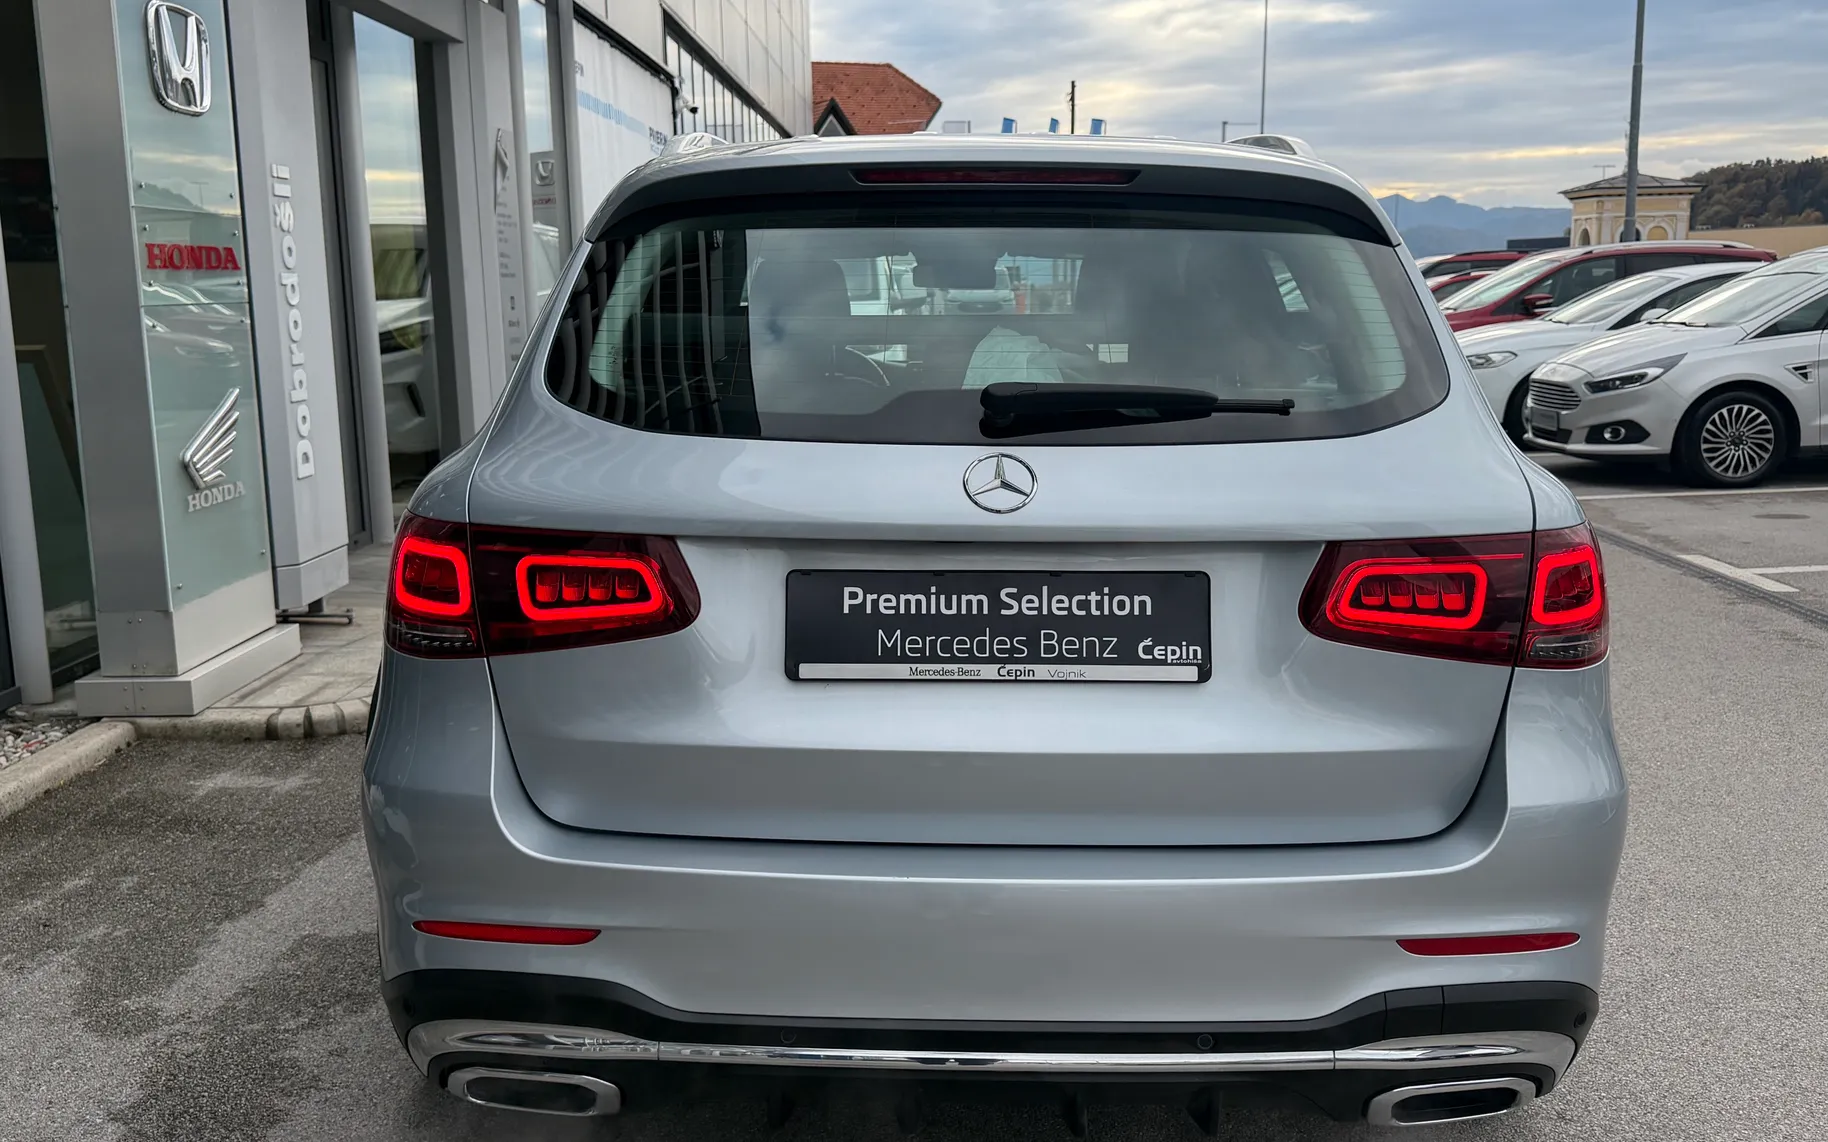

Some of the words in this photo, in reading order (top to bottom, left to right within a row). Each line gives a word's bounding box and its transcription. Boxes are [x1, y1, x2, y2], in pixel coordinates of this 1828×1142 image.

[145, 242, 242, 270] HONDA
[270, 162, 315, 480] Dobrodošli
[187, 480, 246, 512] HONDA
[843, 586, 989, 615] Premium
[1000, 585, 1152, 616] Selection
[878, 627, 1028, 658] Mercedes
[1040, 629, 1118, 658] Benz
[1137, 637, 1202, 663] Čepin
[909, 666, 982, 677] Mercedes-Benz
[1047, 668, 1087, 680] Vojnik
